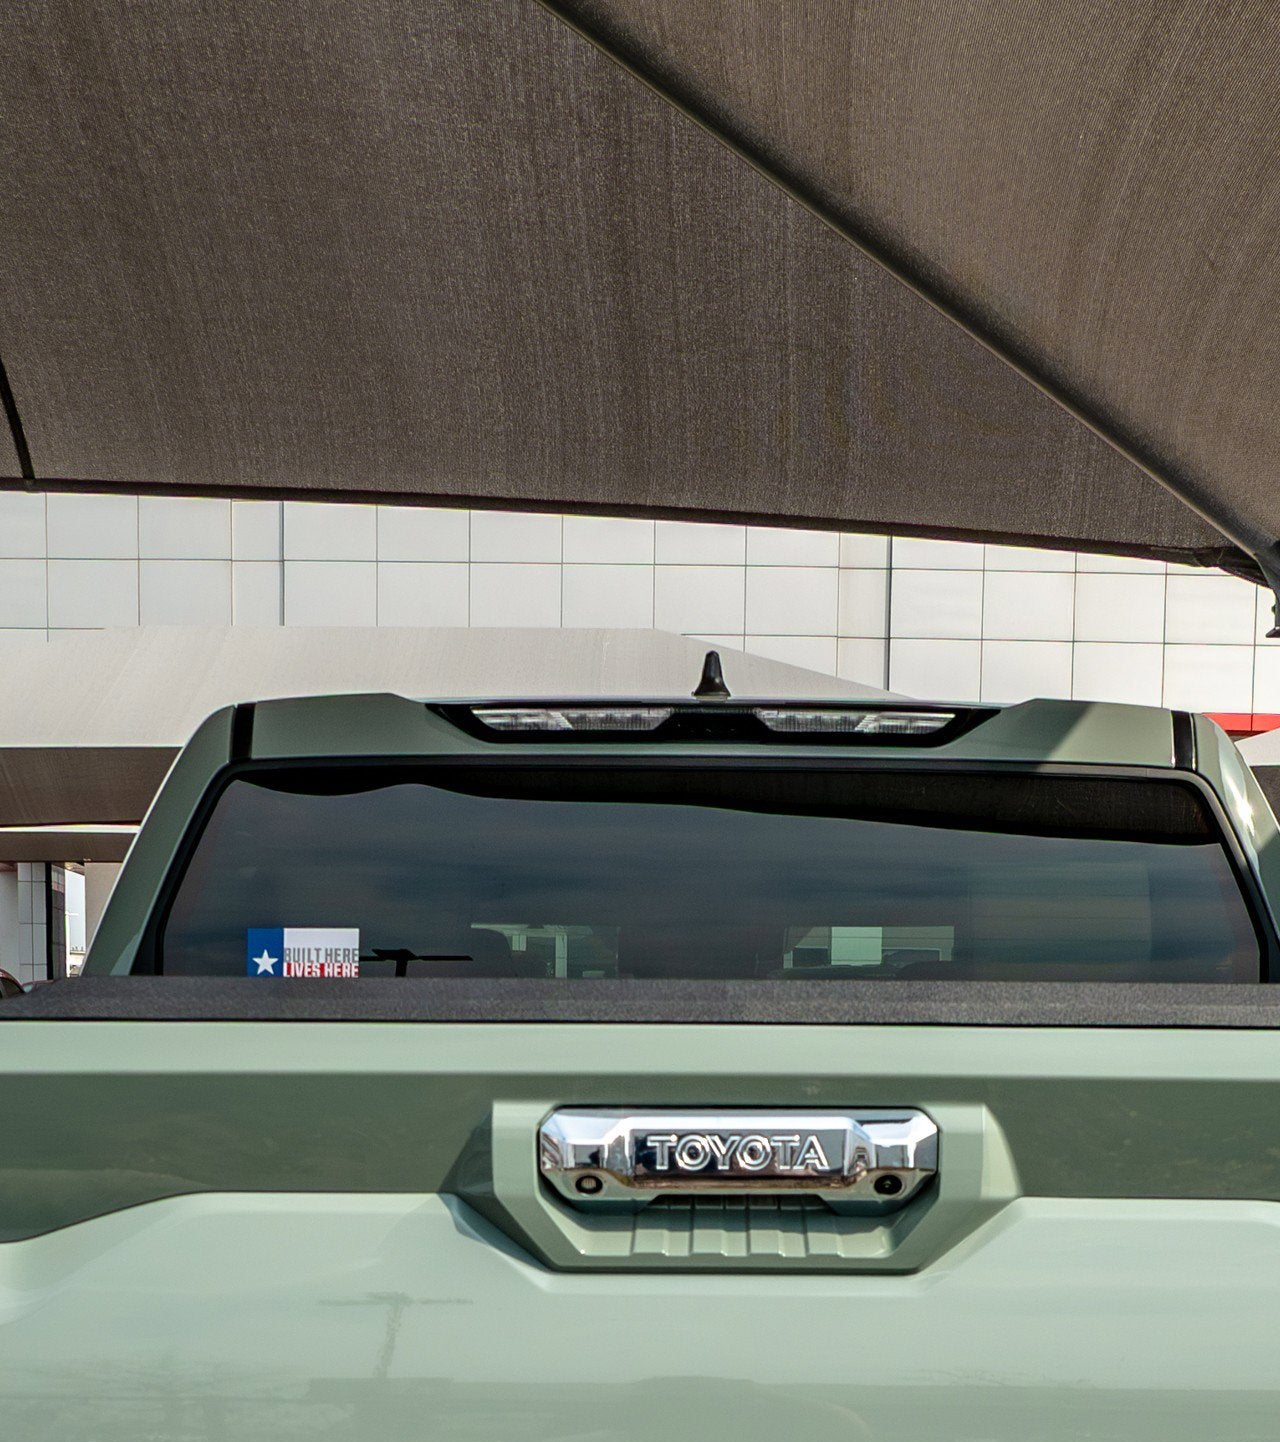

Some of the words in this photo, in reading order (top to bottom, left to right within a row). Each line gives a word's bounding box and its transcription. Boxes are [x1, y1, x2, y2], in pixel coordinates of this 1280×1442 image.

[284, 947, 322, 963] BUILT
[324, 947, 359, 963] HERE
[283, 962, 321, 978] LIVES
[324, 962, 359, 978] HERE
[646, 1134, 830, 1171] TOYOTA
